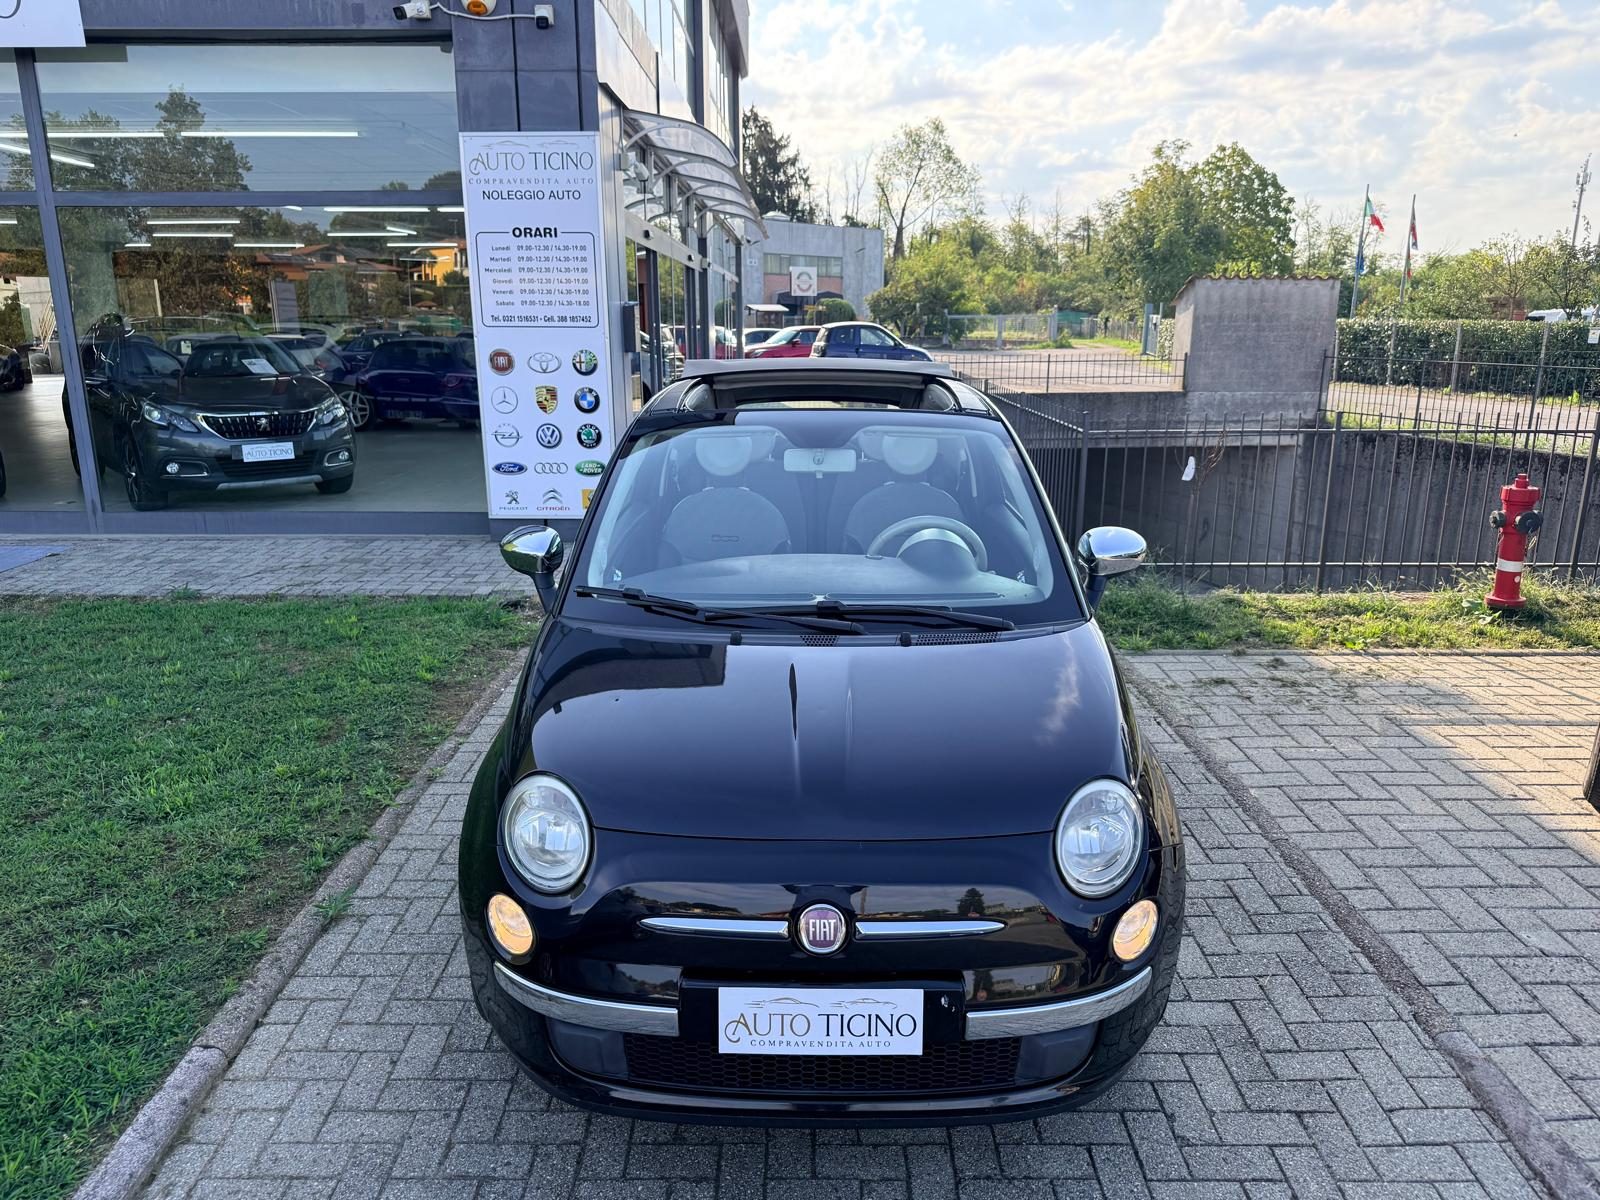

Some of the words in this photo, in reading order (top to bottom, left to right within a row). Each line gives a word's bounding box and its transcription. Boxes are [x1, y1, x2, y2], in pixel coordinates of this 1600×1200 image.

[468, 152, 525, 176] AUTO
[528, 152, 593, 171] TICINO
[482, 190, 545, 201] NOLEGGIO
[548, 190, 581, 201] AUTO
[512, 227, 558, 239] ORARI
[494, 356, 508, 368] FIAT
[499, 464, 519, 473] Ford
[809, 919, 836, 940] FIAT
[724, 1013, 811, 1043] AUTO
[818, 1013, 917, 1037] TICINO
[750, 1039, 854, 1047] COMPRAVENDITA
